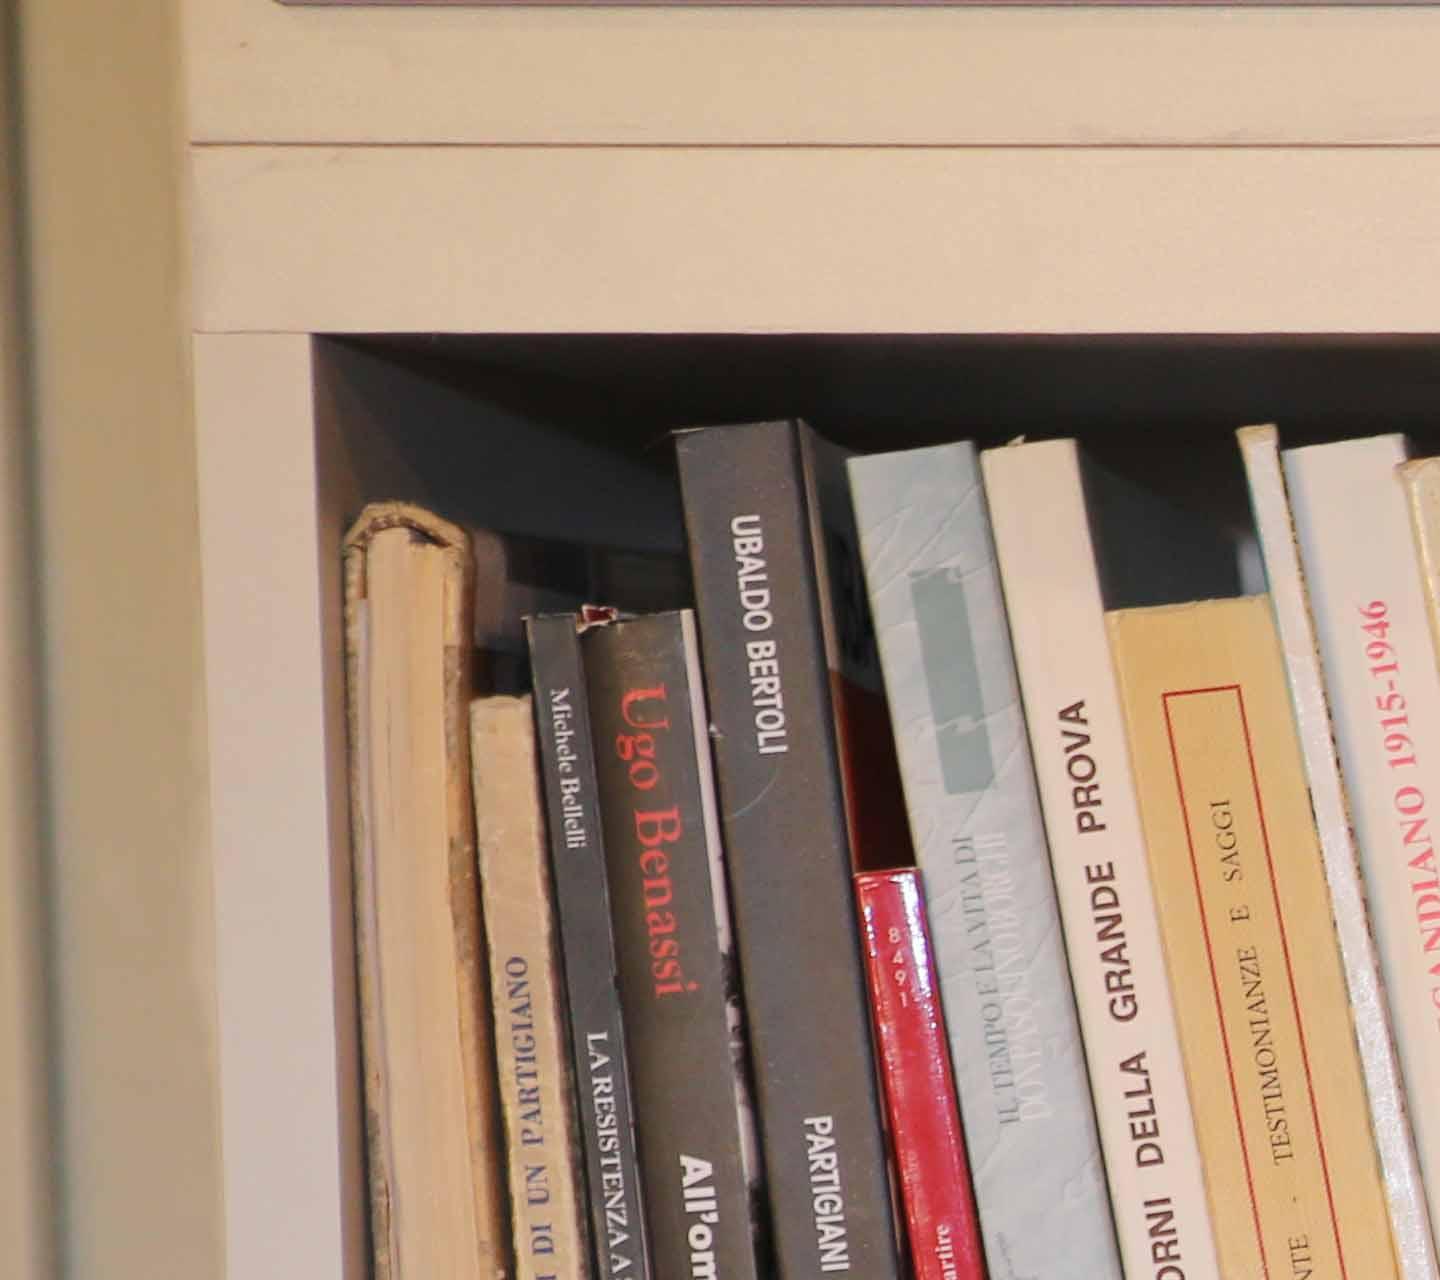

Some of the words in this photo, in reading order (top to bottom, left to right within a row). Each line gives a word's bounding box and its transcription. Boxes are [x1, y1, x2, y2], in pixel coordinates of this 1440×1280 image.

[730, 515, 771, 631] UBALDO
[615, 684, 668, 791] Ugo
[747, 641, 788, 754] BERTOLI
[1364, 601, 1419, 773] 1915-1946
[1056, 700, 1105, 835] PROVA
[633, 807, 699, 999] Benassi
[1083, 863, 1138, 1023] GRANDE
[1120, 1051, 1162, 1169] DELLA
[804, 1115, 850, 1272] PARTIGIANI
